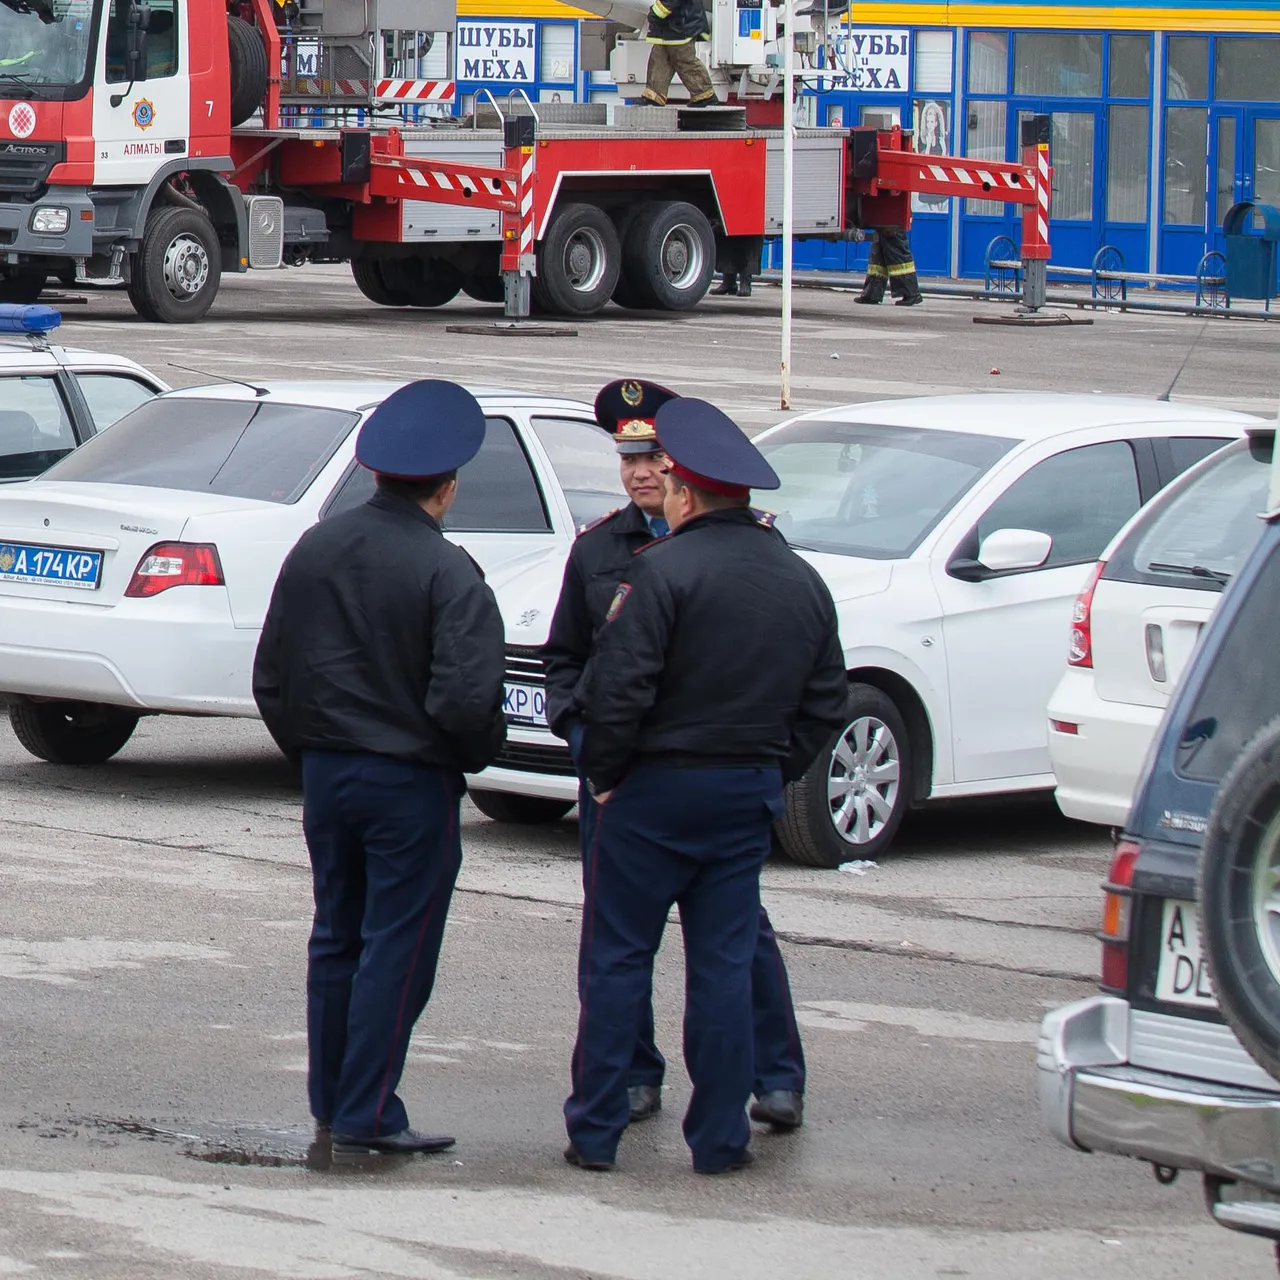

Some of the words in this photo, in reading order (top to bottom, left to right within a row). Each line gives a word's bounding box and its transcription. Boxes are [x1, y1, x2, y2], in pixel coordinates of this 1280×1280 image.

[459, 27, 534, 48] ШУБЫ
[491, 49, 499, 57] и
[463, 59, 528, 79] МЕХА
[205, 100, 214, 117] 7
[100, 151, 109, 159] 33
[124, 143, 162, 155] АЛМАТЫ
[14, 550, 27, 573] A
[33, 551, 62, 577] 174
[66, 556, 92, 579] KP
[1167, 905, 1187, 952] A
